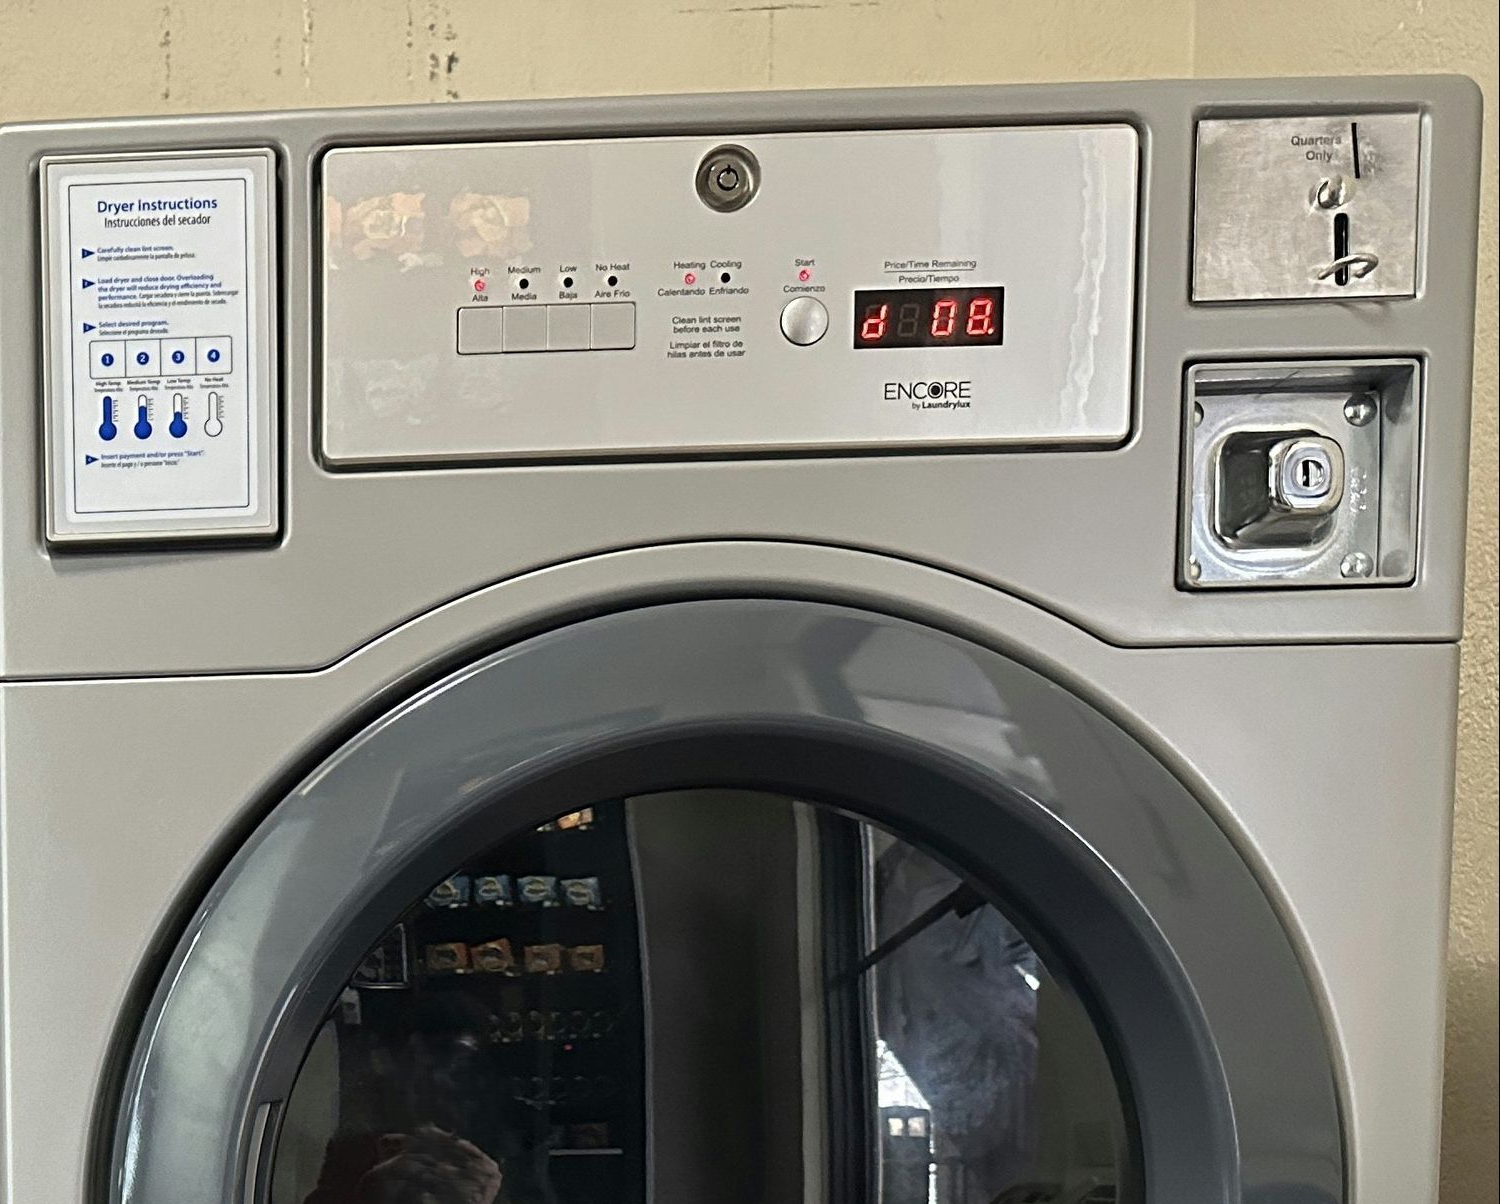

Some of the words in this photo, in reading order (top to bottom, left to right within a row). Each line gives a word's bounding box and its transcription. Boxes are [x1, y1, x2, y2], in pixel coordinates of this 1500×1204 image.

[1291, 136, 1342, 146] Quarters
[1306, 150, 1333, 163] Only
[98, 201, 134, 215] Dryer
[138, 198, 217, 211] Instructions
[105, 217, 160, 228] Instrucciones
[163, 215, 175, 226] del
[178, 213, 211, 225] secador
[674, 262, 706, 270] Heating
[710, 261, 742, 269] Cooling
[795, 259, 815, 267] Start
[884, 261, 929, 269] Price/Time
[932, 260, 977, 269] Remaining
[471, 268, 490, 277] High
[559, 265, 577, 273] Low
[899, 275, 959, 283] Precio/Tiempo
[658, 288, 705, 296] Calentando
[709, 287, 749, 295] Enfriando
[783, 285, 825, 293] Comienzo
[559, 291, 578, 299] Baja
[594, 290, 611, 298] Aire
[672, 316, 697, 324] Clean
[670, 341, 700, 350] Limpiar
[884, 381, 971, 400] ENCORE
[912, 402, 920, 410] by
[922, 401, 970, 410] Laundrylux
